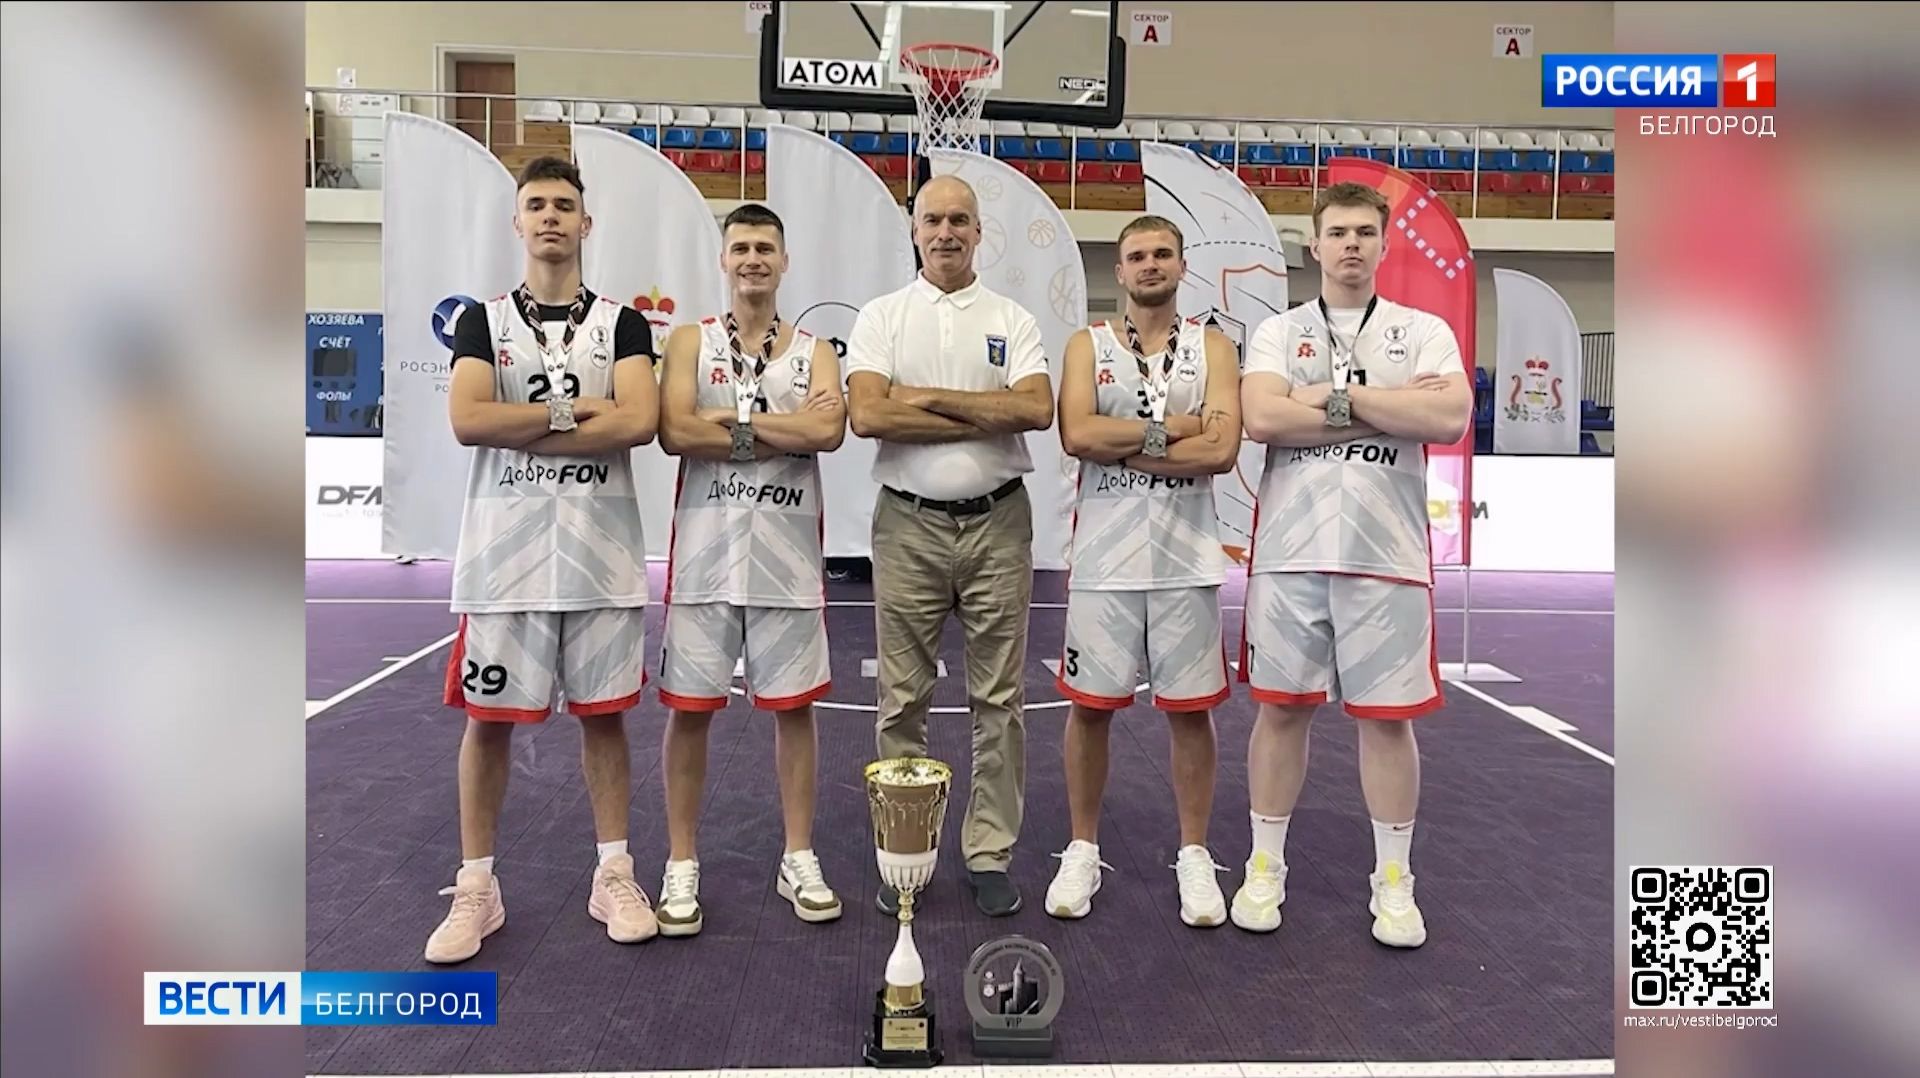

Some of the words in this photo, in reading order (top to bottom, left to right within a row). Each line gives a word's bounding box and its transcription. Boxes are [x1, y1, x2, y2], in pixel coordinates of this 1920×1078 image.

[1134, 14, 1169, 22] СЕКТОР
[1143, 25, 1158, 42] А
[1496, 27, 1531, 35] СЕКТОР
[1505, 38, 1520, 55] А
[308, 314, 365, 326] ХОЗЯЕВА
[319, 336, 352, 348] СЧЁТ
[400, 361, 449, 374] РОСЭН
[316, 391, 352, 401] ФОЛЫ
[1137, 390, 1153, 418] 3
[1066, 647, 1079, 677] 3
[462, 660, 507, 696] 29
